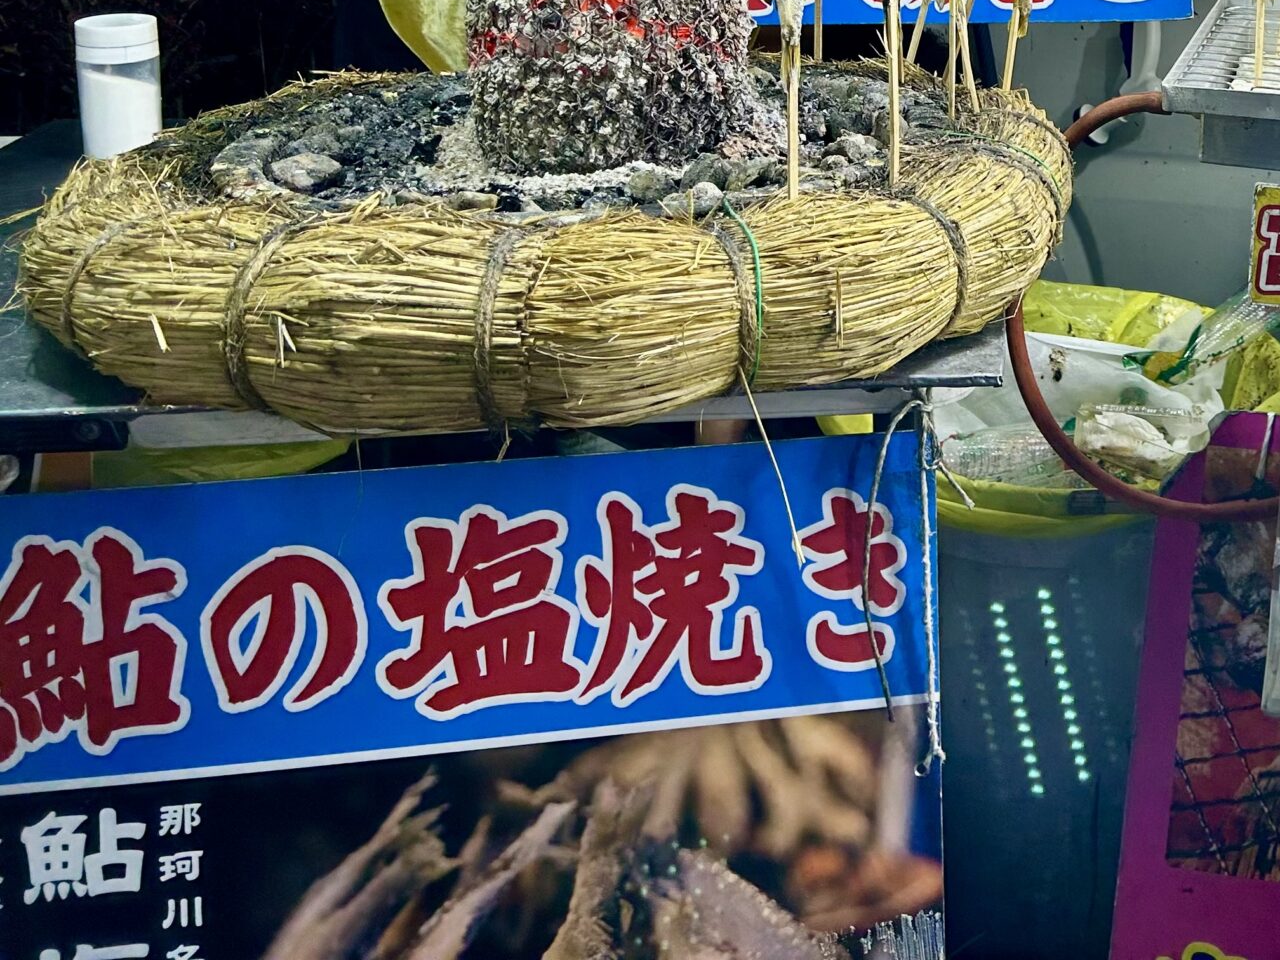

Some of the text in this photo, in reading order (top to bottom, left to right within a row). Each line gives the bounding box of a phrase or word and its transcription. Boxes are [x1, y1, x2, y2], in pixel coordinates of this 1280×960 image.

[0, 483, 907, 772] 鮎の塩焼き
[21, 807, 150, 960] 鮎
